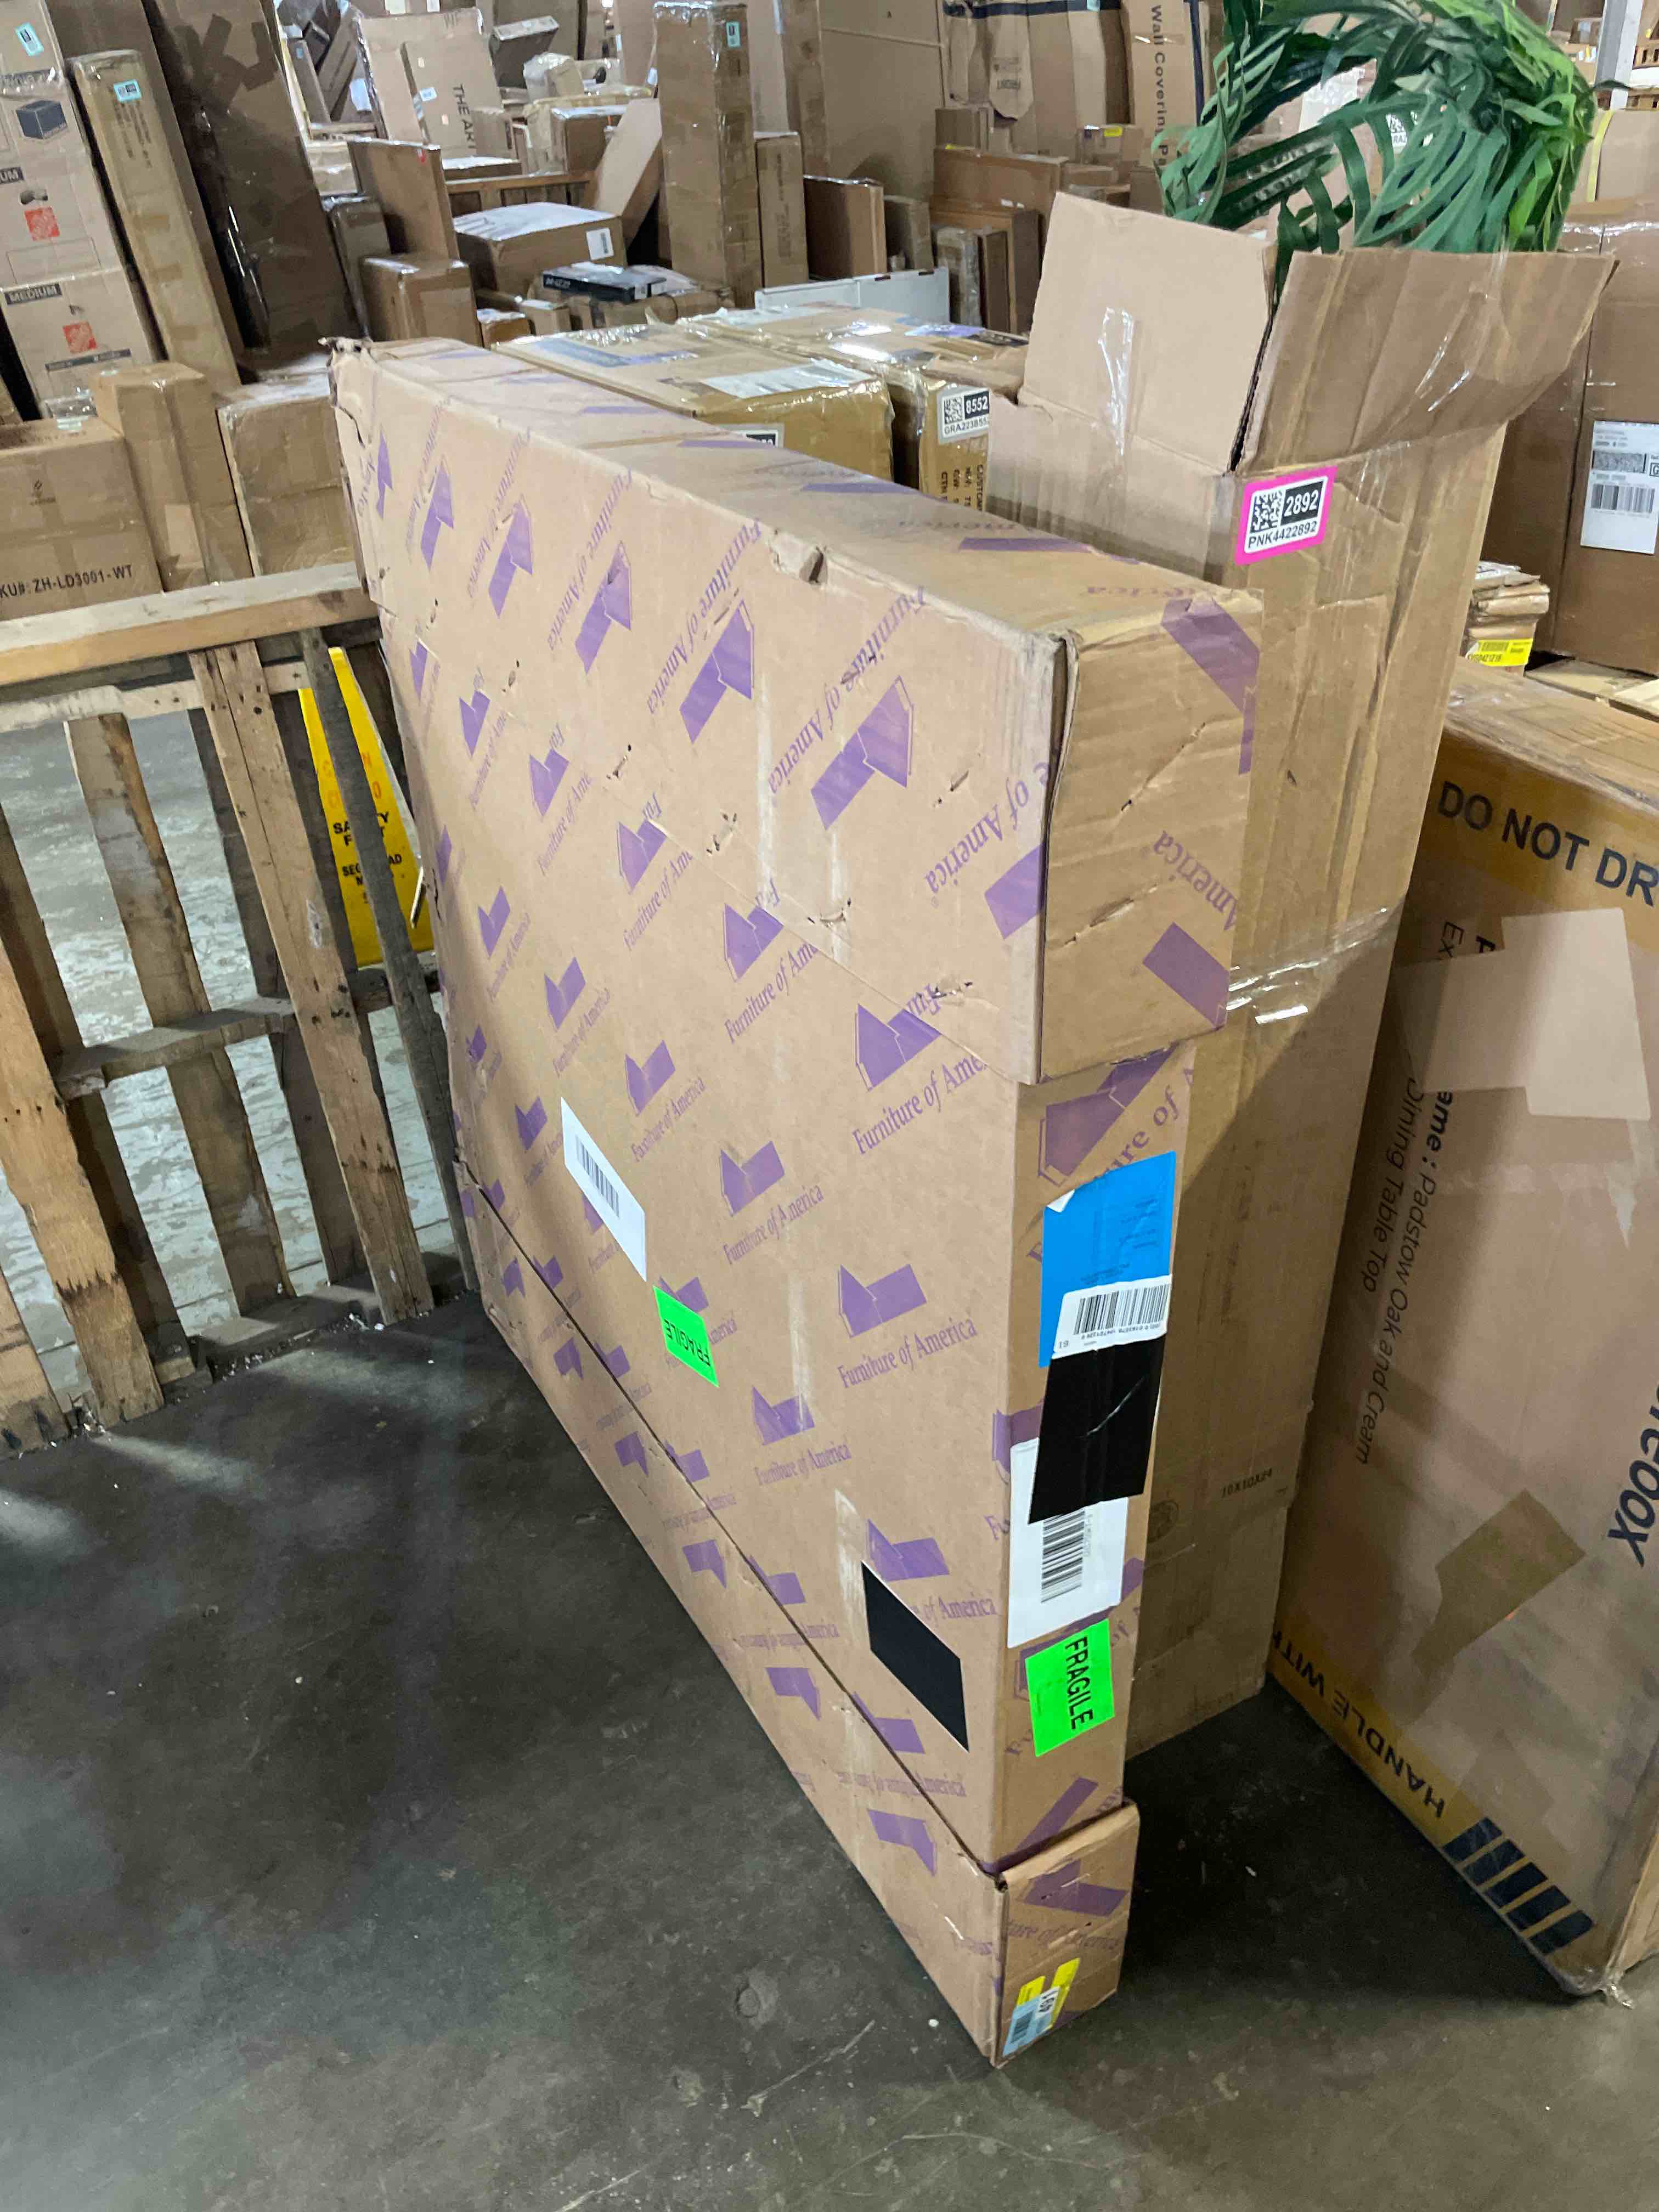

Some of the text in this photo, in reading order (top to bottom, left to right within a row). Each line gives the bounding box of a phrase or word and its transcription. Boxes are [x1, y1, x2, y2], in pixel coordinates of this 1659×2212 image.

[1150, 4, 1164, 46] Wall
[9, 284, 57, 302] MEDIUM
[965, 395, 988, 414] 8552
[1284, 489, 1321, 518] 2892
[1248, 521, 1318, 550] PNK4422892
[32, 564, 133, 593] ZH-LD3001-WT
[699, 517, 761, 619] Furniture
[839, 586, 927, 692] Furniture
[647, 634, 688, 714] America
[768, 709, 823, 794] America
[924, 777, 1029, 894] of America
[1437, 781, 1493, 831] DO
[1501, 808, 1589, 871] NOT
[1153, 830, 1238, 931] America
[724, 983, 775, 1044] Furniture
[852, 1094, 923, 1155] Furniture
[1153, 1084, 1179, 1126] of
[722, 1224, 768, 1265] Furniture
[776, 1184, 825, 1228] America
[1373, 1178, 1404, 1244] Table
[1396, 1173, 1437, 1280] Padstow
[1363, 1247, 1392, 1294] Top
[664, 1318, 711, 1367] FRAGILE
[1383, 1284, 1409, 1339] Oak
[837, 1351, 898, 1389] Furniture
[913, 1316, 978, 1359] America
[1372, 1339, 1393, 1392] and
[1356, 1391, 1385, 1465] Cream
[938, 1592, 998, 1620] America
[1064, 1636, 1093, 1731] FRAGILE
[1333, 1690, 1445, 1818] HANDLE
